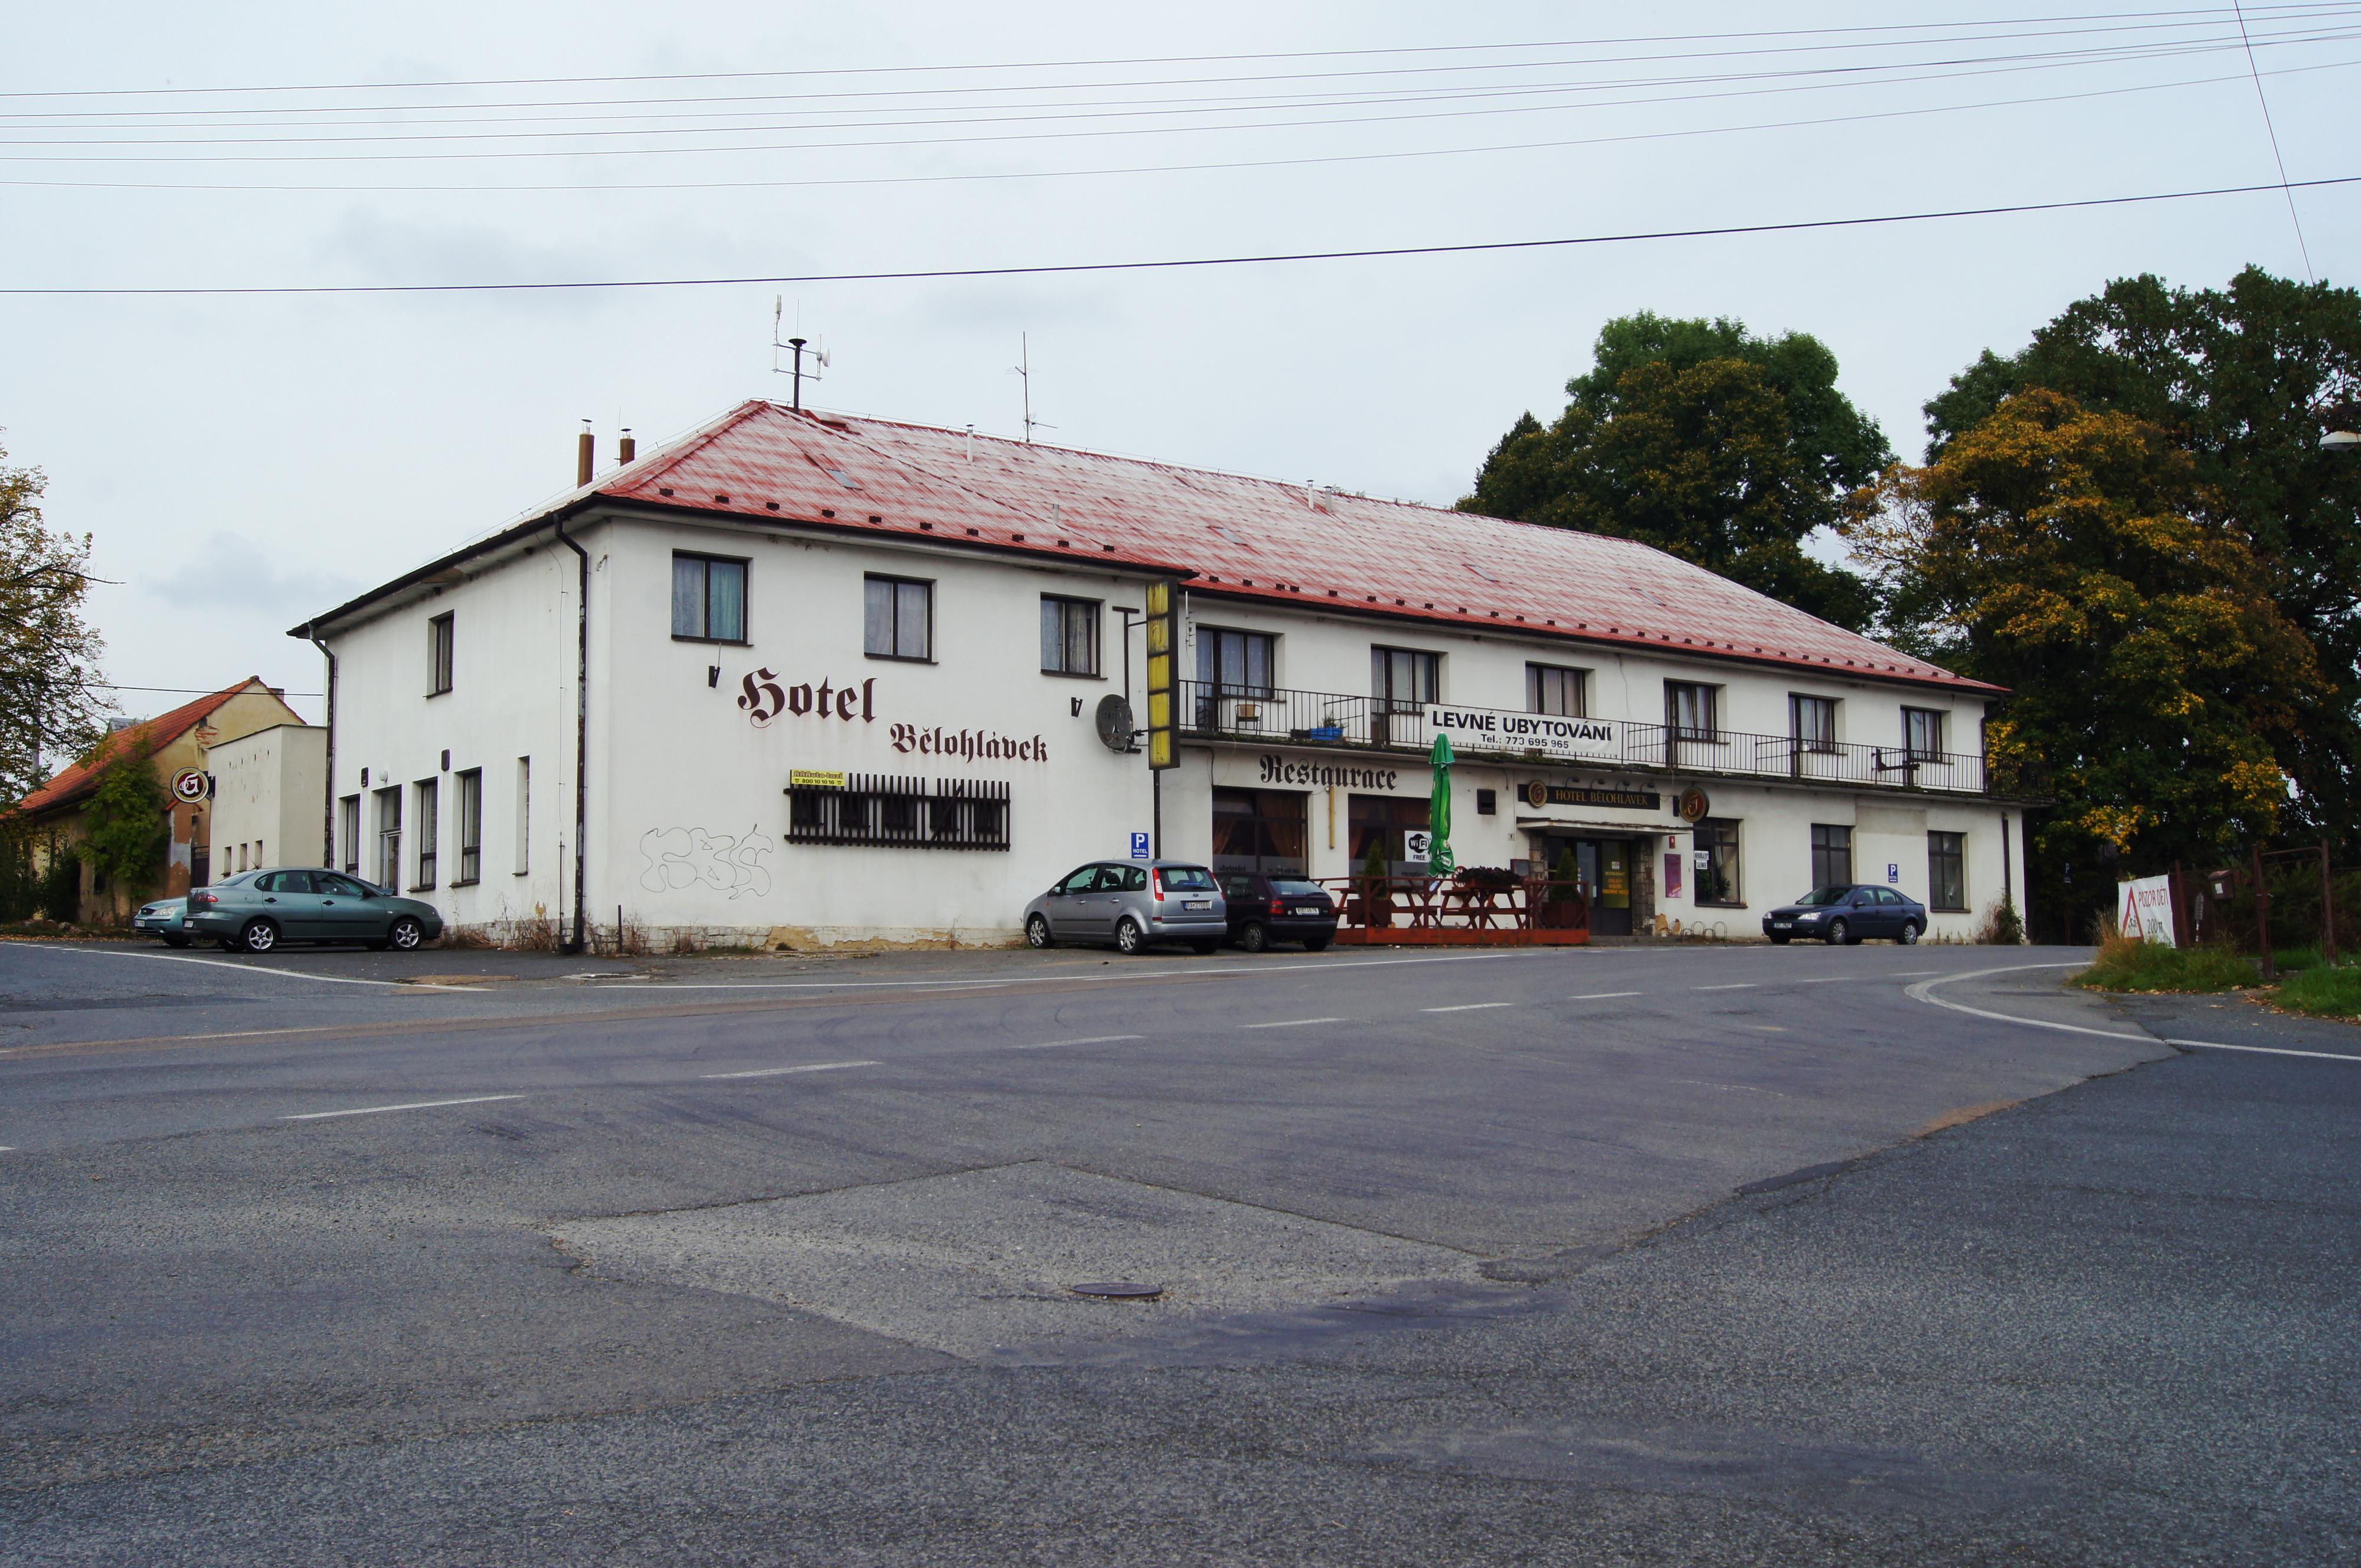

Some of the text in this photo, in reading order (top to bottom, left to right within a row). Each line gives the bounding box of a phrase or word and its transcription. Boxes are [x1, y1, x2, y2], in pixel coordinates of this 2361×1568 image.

[738, 667, 878, 728] Hotel
[1433, 711, 1611, 741] LEVNÉ UBYTOVÁNÍ
[890, 724, 1048, 764] Bělohlávek
[1481, 734, 1569, 749] Tel.: 773 695 965
[1260, 754, 1398, 790] Restaurace
[1556, 790, 1587, 802] HOTEL
[1136, 834, 1145, 848] P
[1891, 865, 1896, 875] P
[2138, 890, 2156, 908] POZOR
